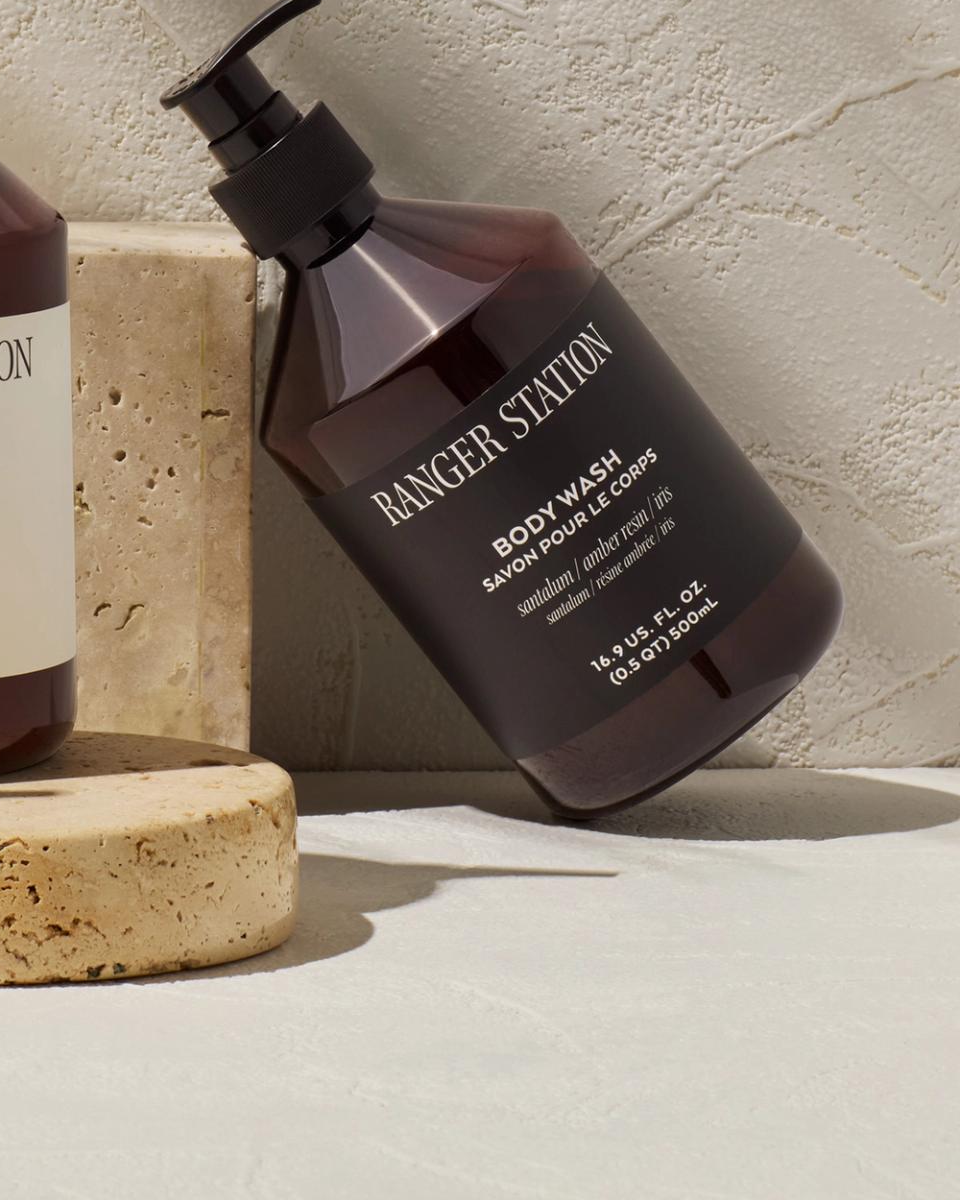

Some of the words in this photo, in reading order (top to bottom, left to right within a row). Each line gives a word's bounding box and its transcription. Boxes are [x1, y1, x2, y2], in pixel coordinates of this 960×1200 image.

[369, 424, 509, 527] RANGER
[498, 321, 613, 440] STATION
[482, 548, 539, 593] SAVON
[538, 511, 589, 555] POUR
[589, 492, 611, 517] LE
[610, 447, 658, 497] CORPS
[491, 500, 555, 558] BODY
[555, 448, 622, 507] WASH
[517, 570, 575, 617] santalum
[583, 532, 620, 572] amber
[620, 506, 649, 541] resin
[654, 486, 673, 510] iris
[546, 588, 591, 624] santalum
[595, 562, 623, 590] résine
[623, 534, 656, 569] ambrée
[658, 515, 676, 536] iris
[590, 644, 624, 672] 16.9
[624, 625, 655, 648] US.
[653, 607, 681, 627] FL.
[680, 580, 707, 604] OZ.
[609, 657, 641, 686] (0.5
[640, 635, 671, 662] QT)
[670, 598, 719, 641] 500mL
